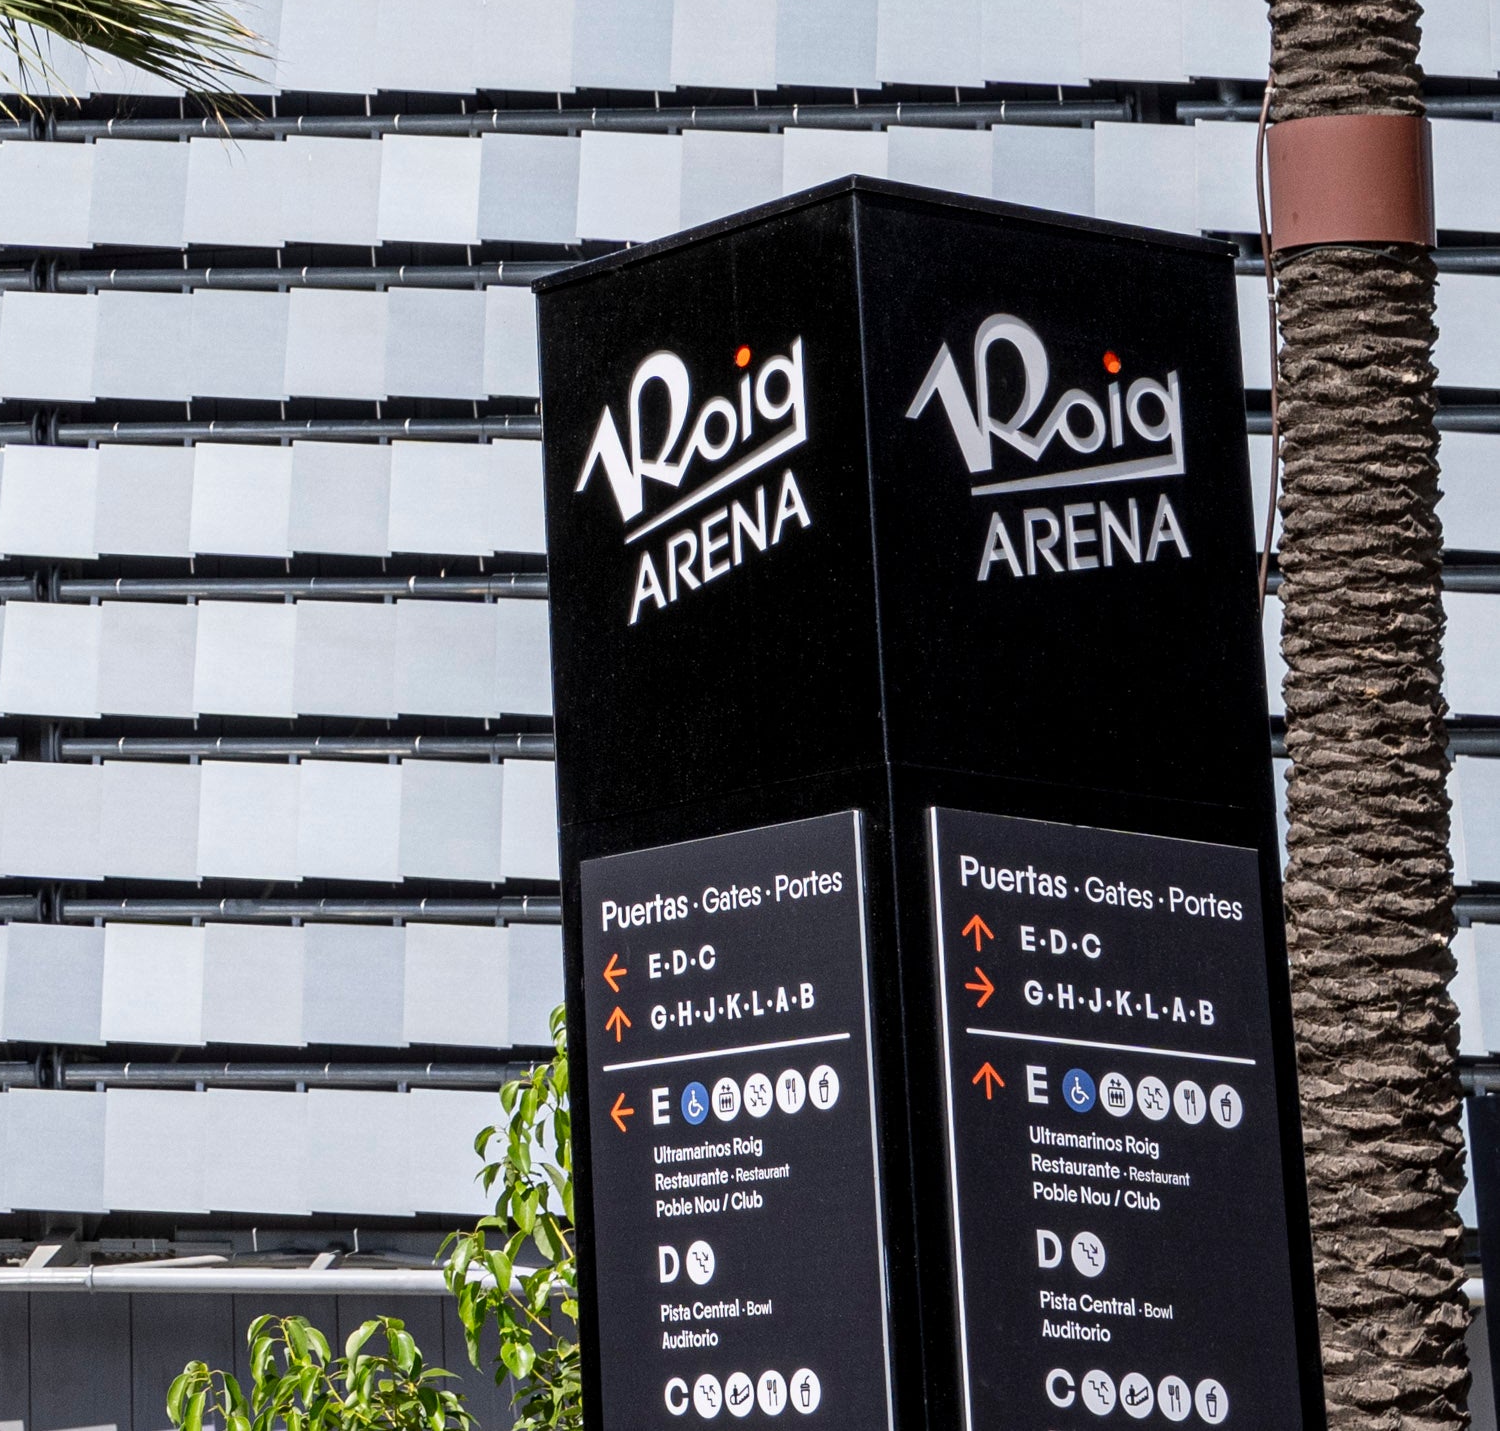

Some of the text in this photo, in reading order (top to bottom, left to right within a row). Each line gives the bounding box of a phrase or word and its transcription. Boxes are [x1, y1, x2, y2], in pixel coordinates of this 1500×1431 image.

[905, 312, 1186, 496] Roig
[574, 335, 807, 545] Roig
[626, 468, 812, 627] ARENA
[977, 493, 1192, 582] ARENA
[601, 894, 688, 932] Puertas
[702, 885, 762, 914] Gates
[775, 870, 843, 903] Portes
[959, 855, 1068, 899] Puertas
[1085, 876, 1154, 910] Gates
[1169, 886, 1243, 921] Portes
[1025, 1065, 1049, 1104] E
[651, 1087, 671, 1125] E
[653, 1136, 764, 1165] Ultramarinos Roig
[1029, 1125, 1160, 1160] Ultramarinos Roig
[654, 1167, 729, 1192] Restaurante
[736, 1163, 790, 1182] Restaurant
[1031, 1153, 1121, 1180] Restaurante
[1129, 1166, 1191, 1187] Restaurant
[655, 1198, 694, 1218] Poble
[694, 1195, 721, 1215] Nou
[731, 1189, 764, 1211] Club
[1032, 1181, 1078, 1203] Poble
[1080, 1185, 1111, 1207] Nou
[1123, 1190, 1161, 1211] Club
[658, 1245, 681, 1284] D
[1036, 1229, 1063, 1269] D
[660, 1303, 692, 1323] Pista
[692, 1298, 740, 1320] Central
[746, 1298, 773, 1316] Bowl
[1039, 1290, 1078, 1312] Pista
[1079, 1294, 1136, 1317] Central
[1143, 1302, 1174, 1320] Bowl
[661, 1328, 719, 1350] Auditorio
[1041, 1318, 1111, 1343] Auditorio
[663, 1376, 690, 1417] C
[1045, 1367, 1076, 1408] C
